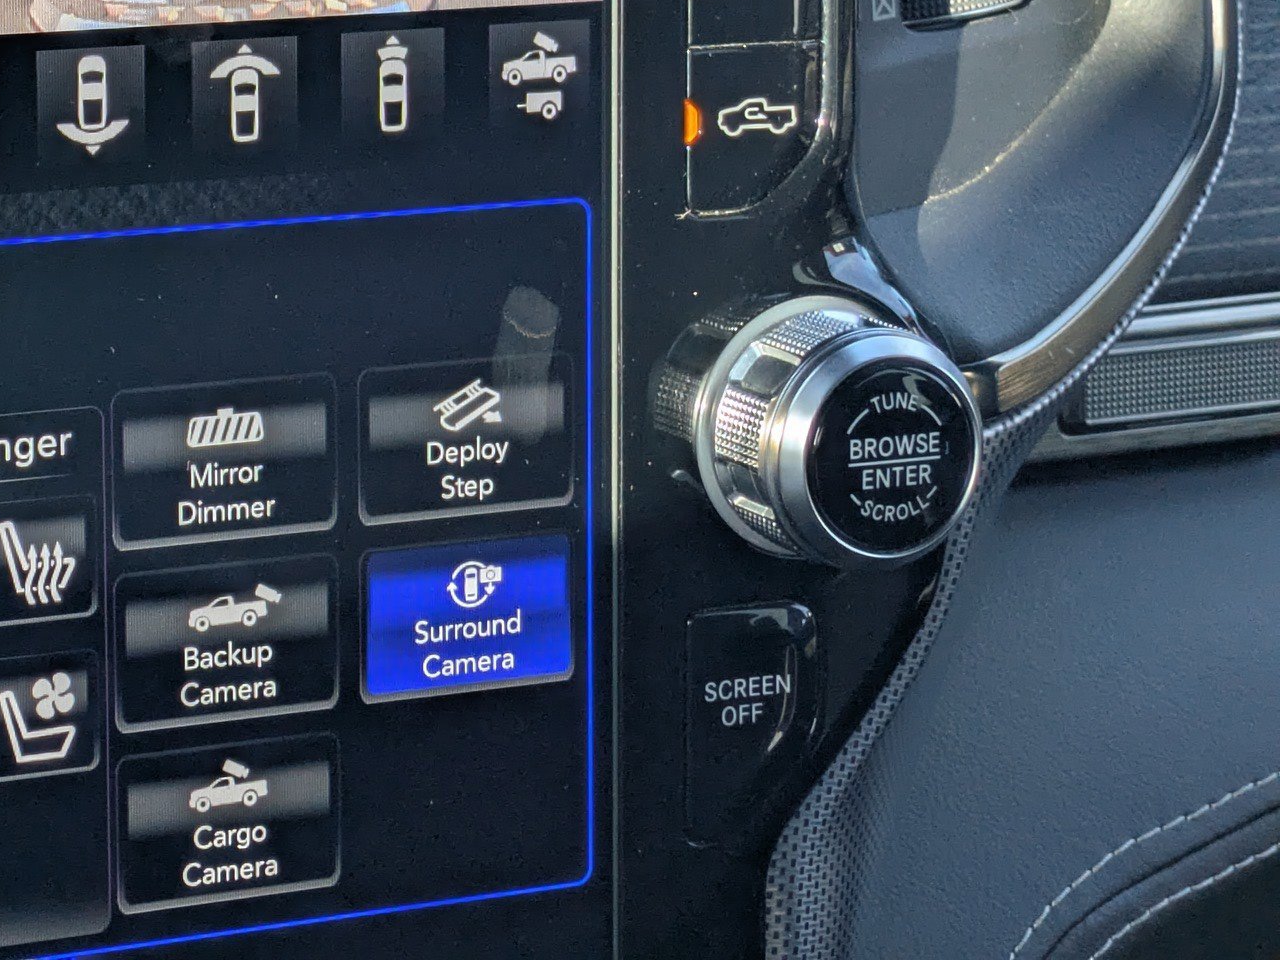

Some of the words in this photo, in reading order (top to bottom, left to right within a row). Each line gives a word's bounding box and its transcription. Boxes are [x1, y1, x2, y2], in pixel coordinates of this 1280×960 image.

[870, 393, 919, 414] TUNE
[426, 437, 508, 467] Deploy
[849, 432, 941, 459] BROWSE
[189, 463, 263, 488] Mirror
[441, 475, 494, 502] Step
[861, 464, 931, 491] ENTER
[178, 498, 275, 525] Dimmer
[860, 496, 930, 523] SCROLL
[414, 610, 521, 645] Surround
[183, 644, 273, 671] Backup
[422, 650, 515, 679] Camera
[180, 678, 277, 708] Camera
[704, 674, 791, 702] SCREEN
[721, 704, 762, 727] OFF
[193, 823, 267, 852] Cargo
[182, 856, 278, 887] Camera
